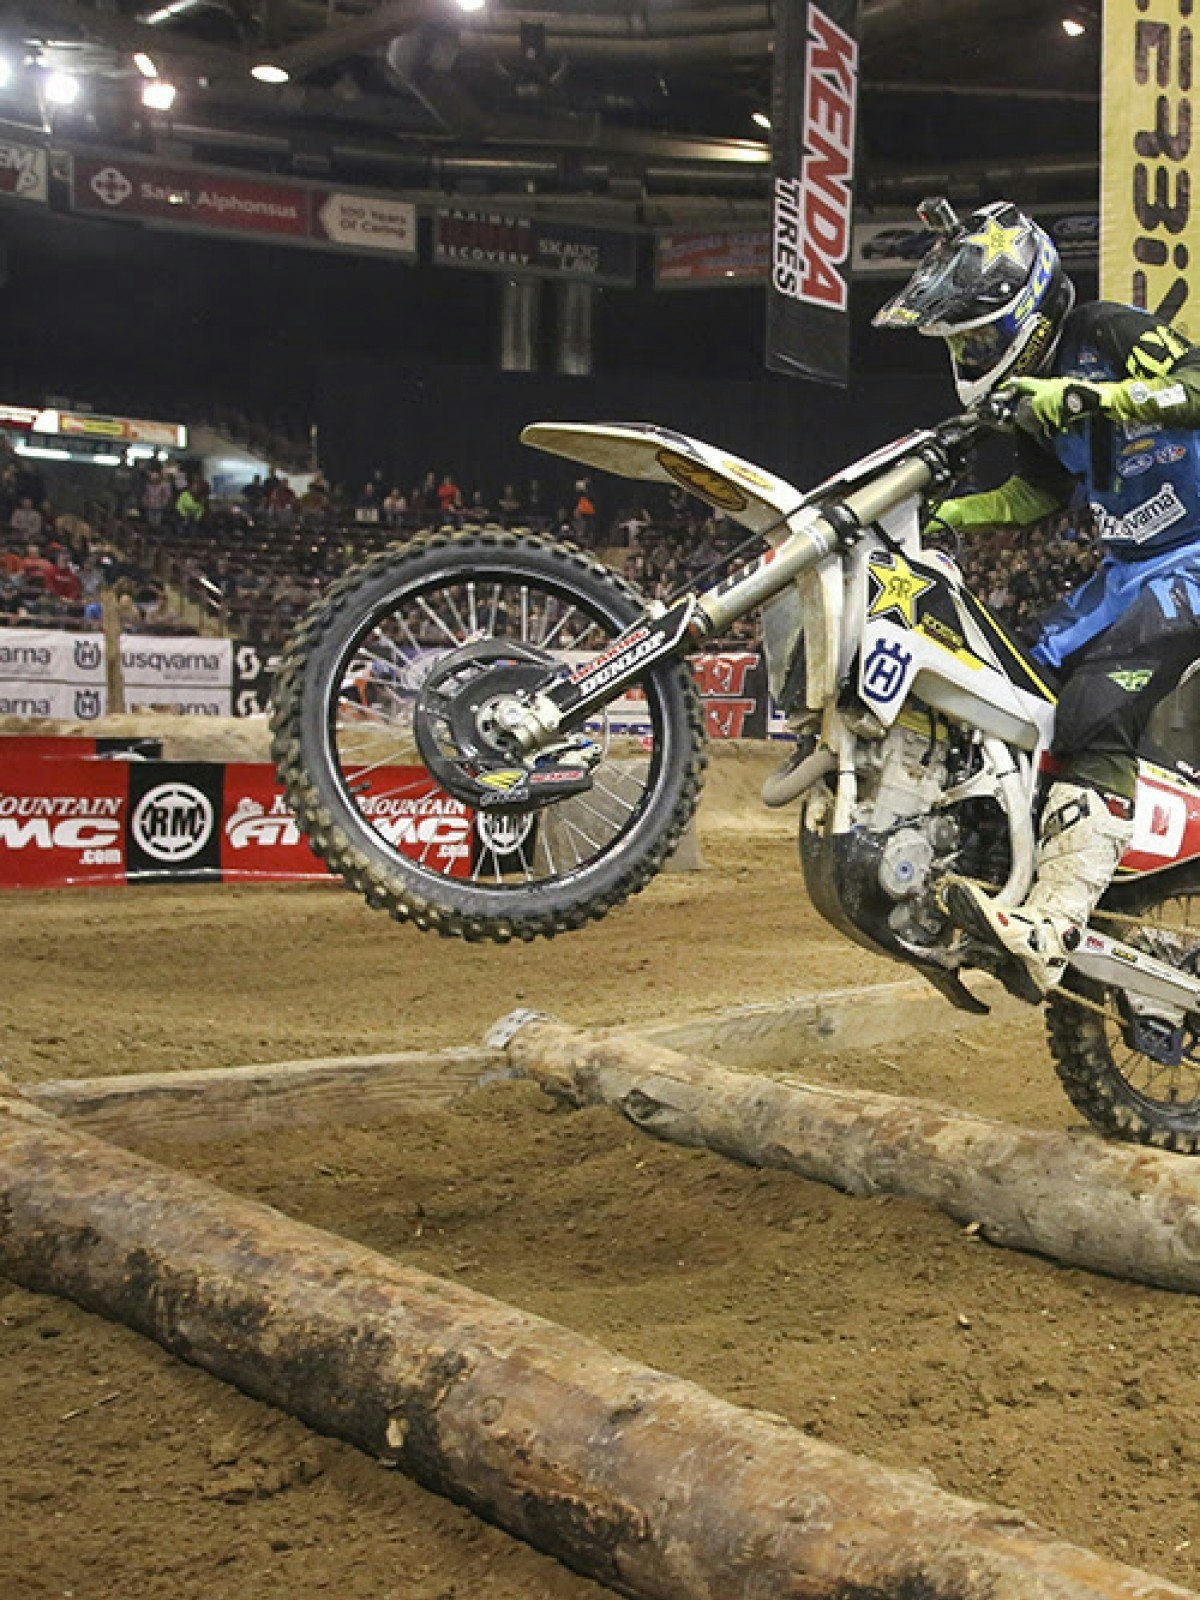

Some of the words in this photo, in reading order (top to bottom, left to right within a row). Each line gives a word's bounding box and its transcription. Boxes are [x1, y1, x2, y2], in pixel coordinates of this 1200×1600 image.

[801, 2, 858, 312] KENDA
[774, 177, 800, 299] TIRES
[121, 651, 220, 672] usqvarna
[0, 796, 123, 816] OUNTAIN
